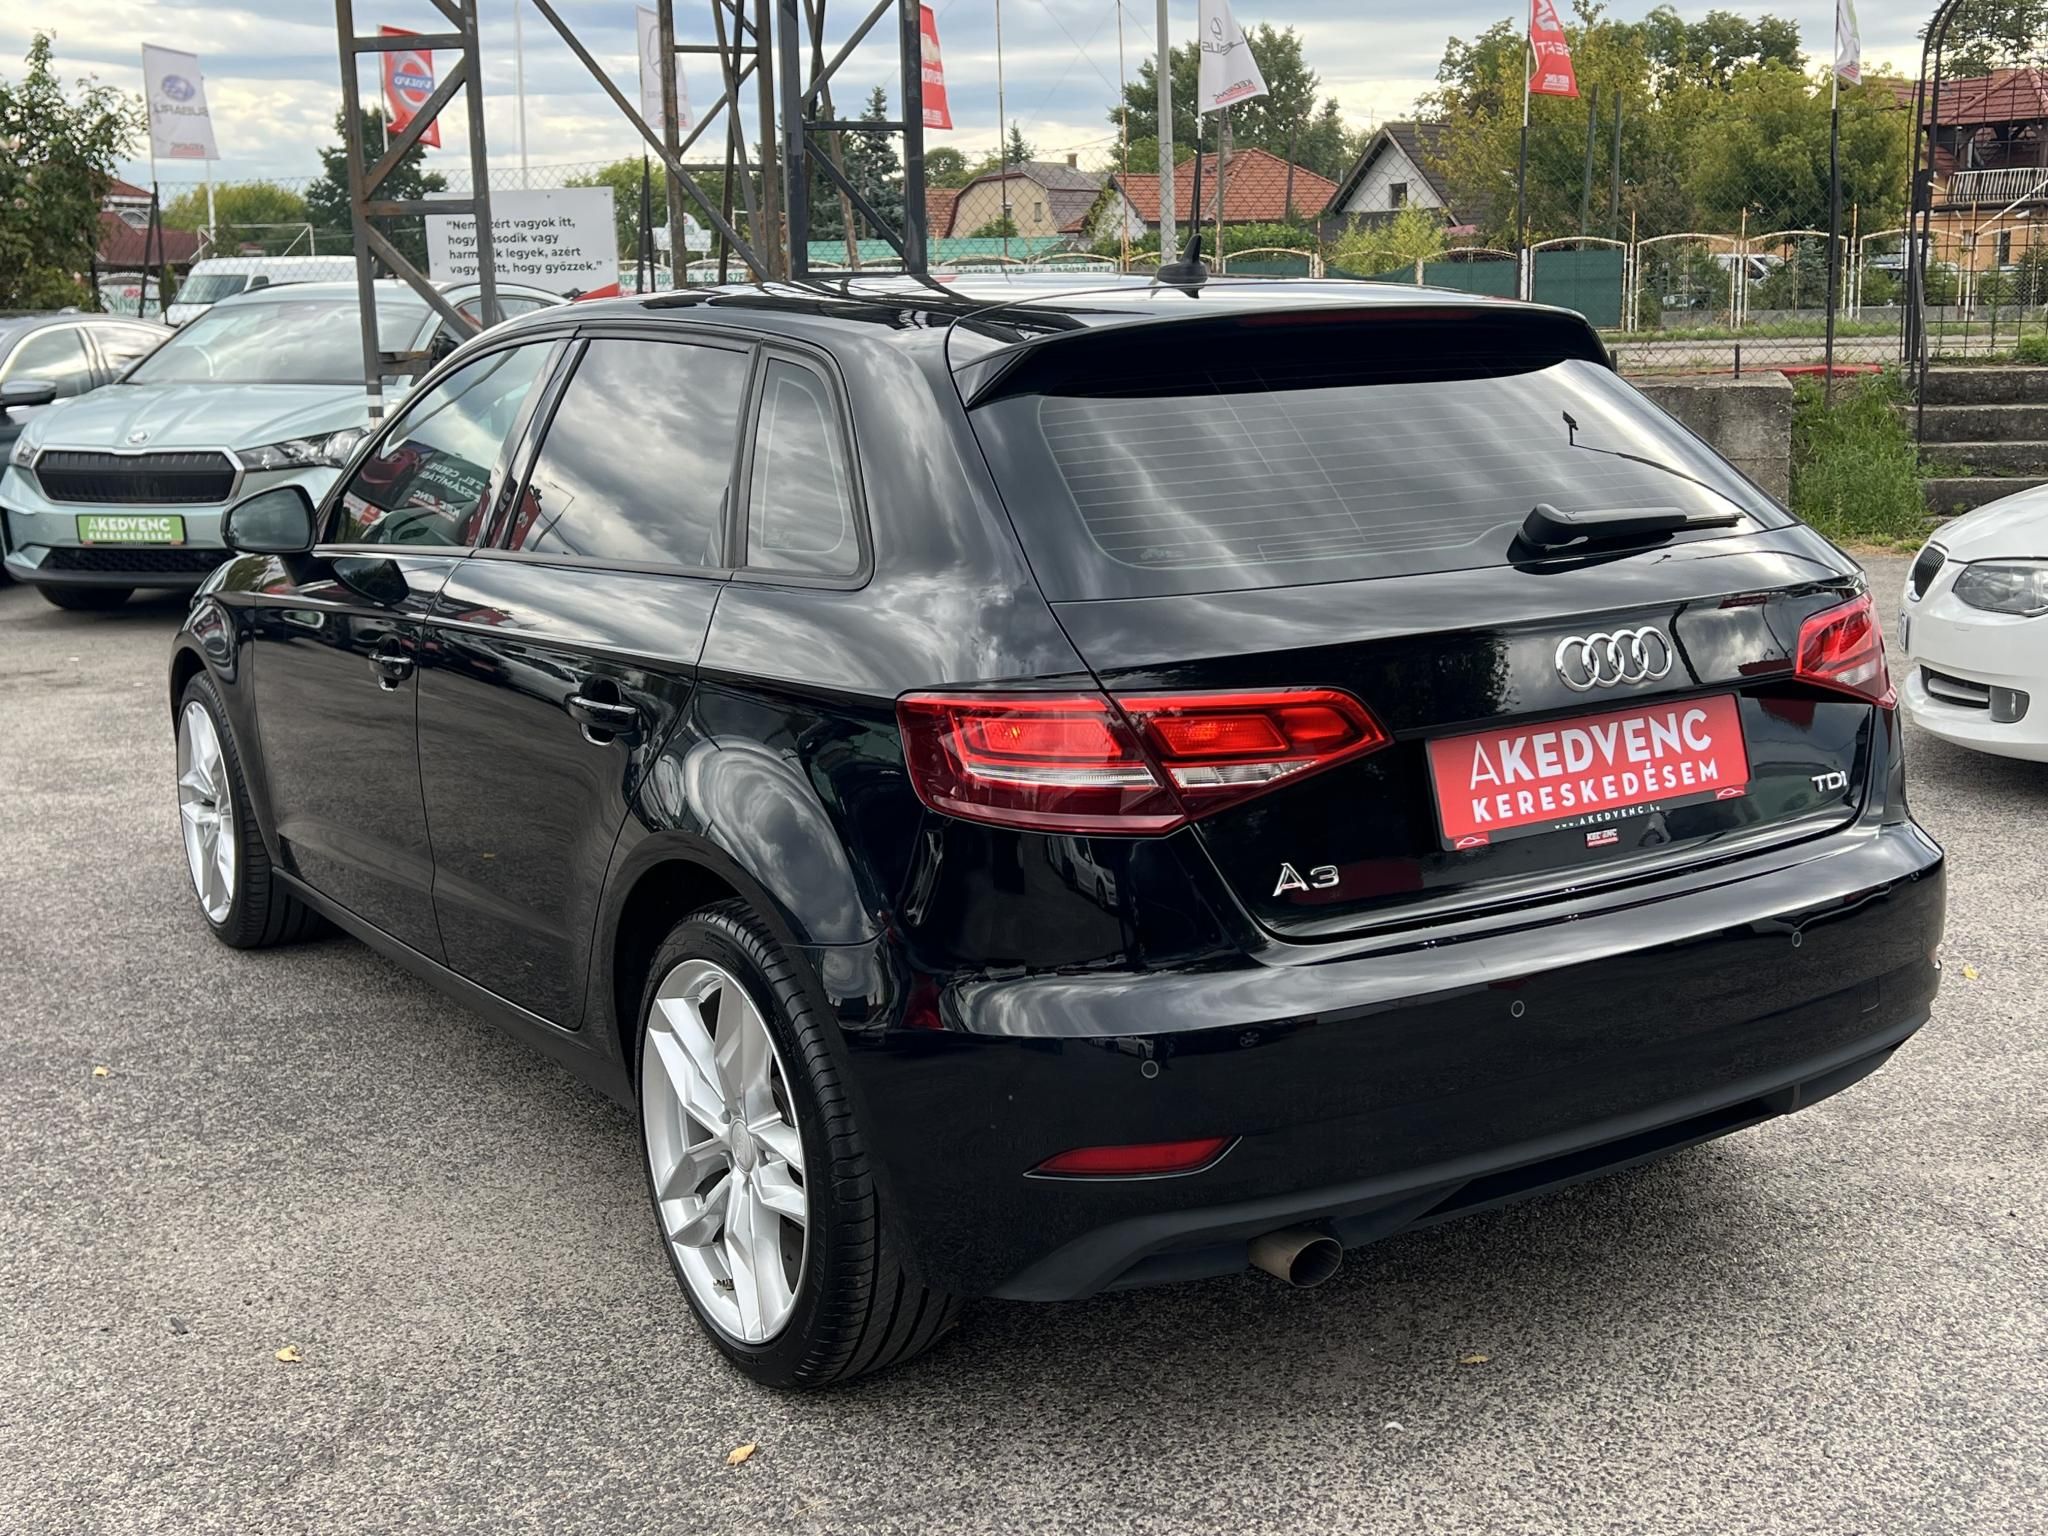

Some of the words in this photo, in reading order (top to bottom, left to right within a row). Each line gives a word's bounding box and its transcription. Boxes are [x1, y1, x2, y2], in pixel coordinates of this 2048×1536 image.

[514, 218, 556, 230] vagyok
[559, 216, 575, 228] itt,
[448, 235, 477, 247] hogy
[531, 234, 559, 244] vagy
[506, 248, 548, 260] legyek,
[551, 246, 581, 257] azért
[513, 262, 542, 274] hogy
[88, 518, 171, 532] AKEDVENC
[1469, 708, 1713, 791] AKEDVENC
[1811, 770, 1848, 792] TDI
[1471, 757, 1719, 824] KERESKEDÉSEM
[1272, 862, 1340, 897] A3
